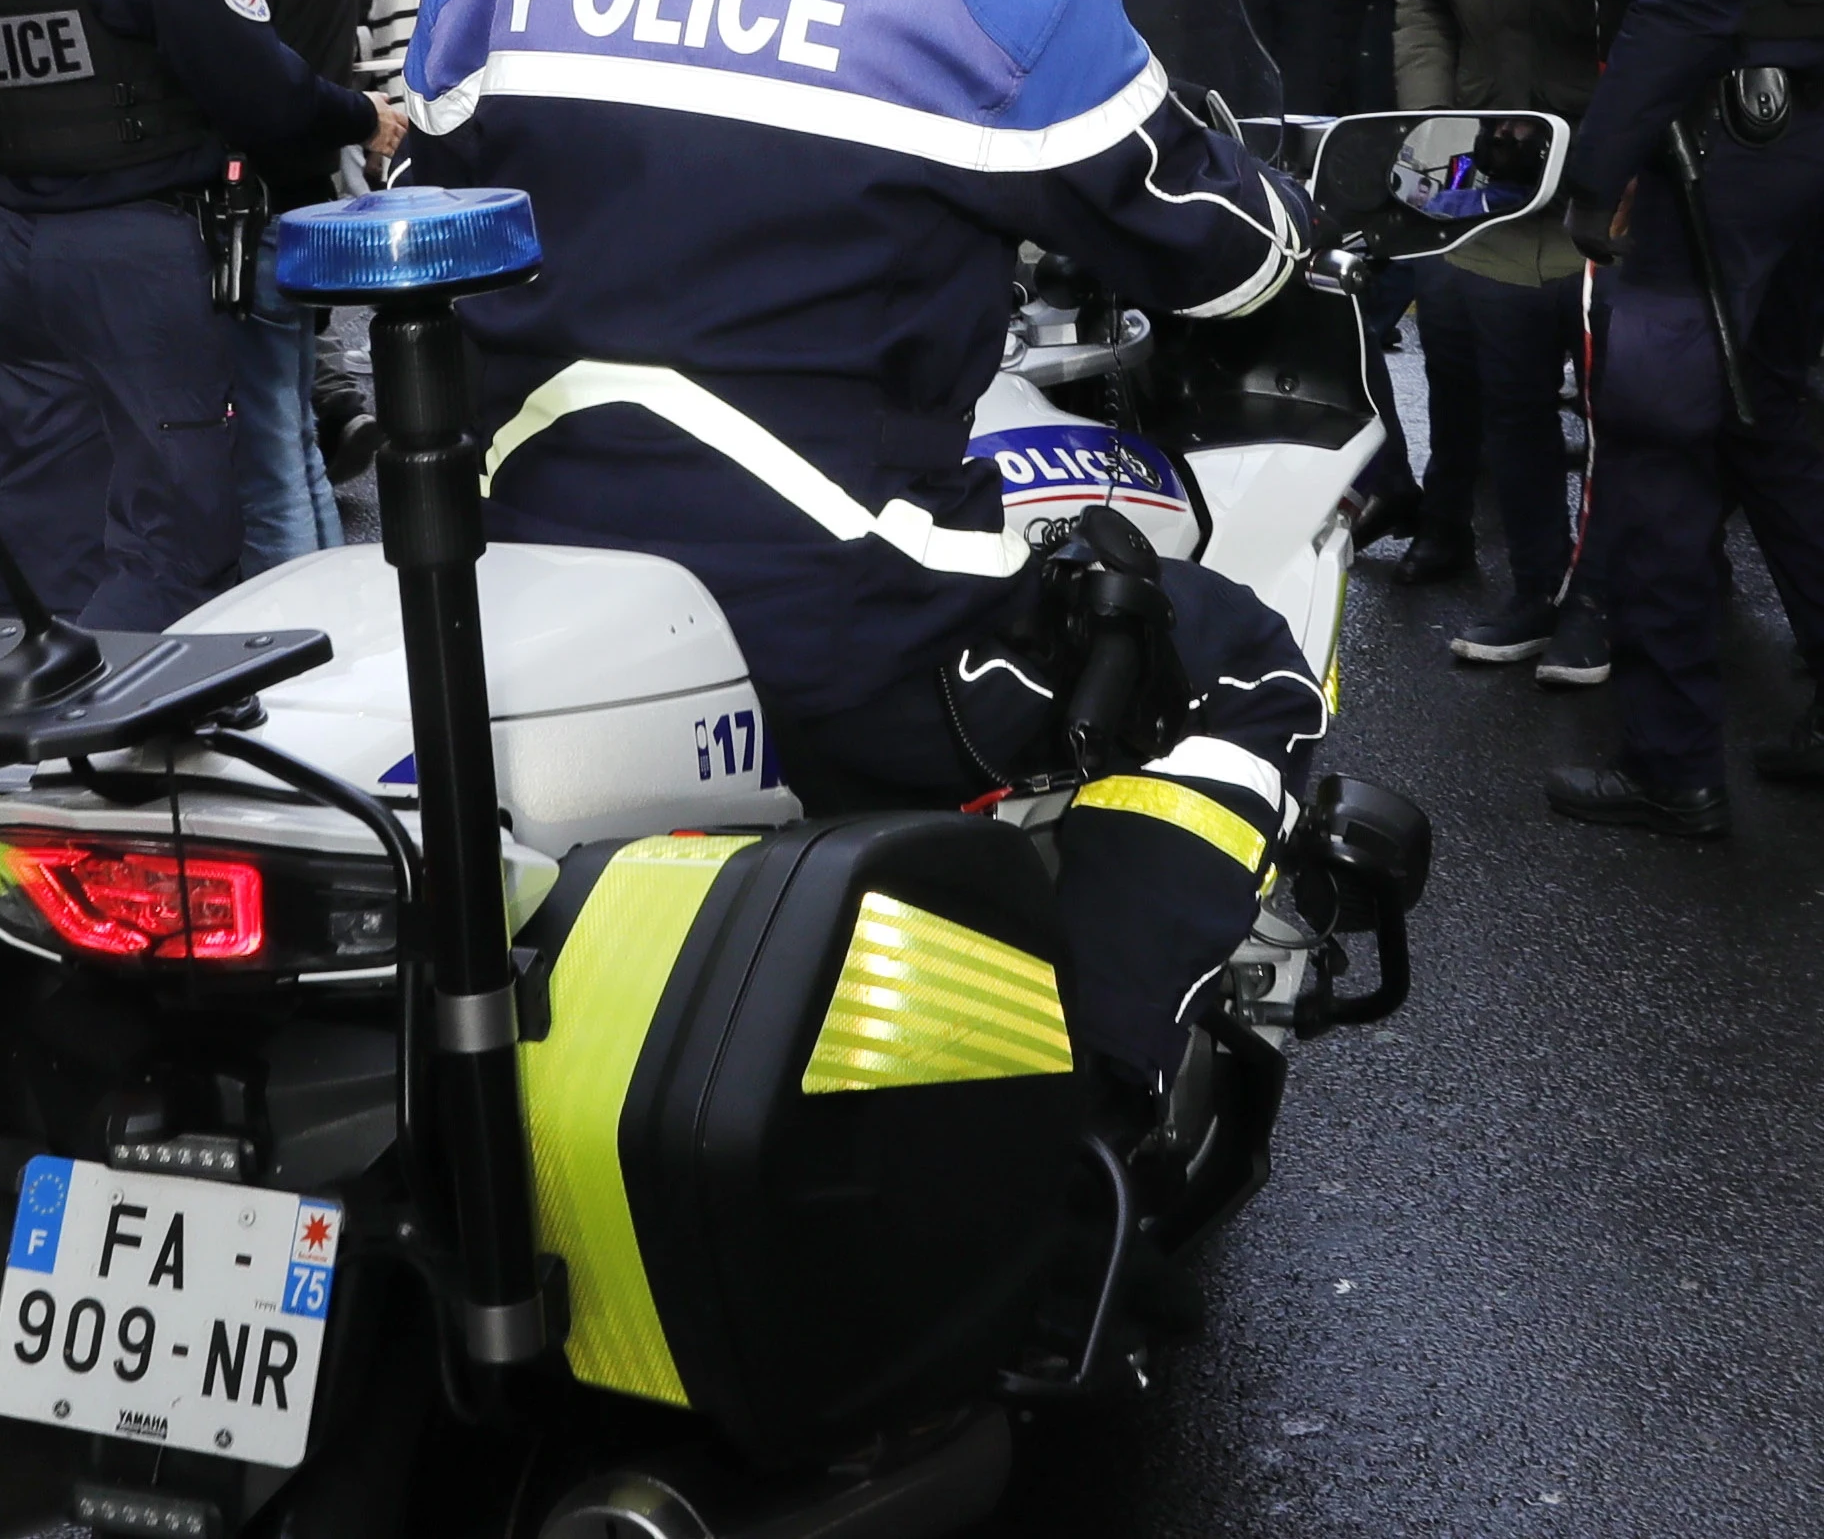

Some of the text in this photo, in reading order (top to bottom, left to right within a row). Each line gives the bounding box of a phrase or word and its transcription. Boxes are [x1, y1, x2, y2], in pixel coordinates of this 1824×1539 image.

[968, 446, 1134, 485] OLICE
[712, 708, 756, 776] 17
[27, 1228, 48, 1256] F
[290, 1266, 327, 1311] 75
[13, 1289, 299, 1412] 909-NR
[119, 1408, 168, 1432] YAMAHA
